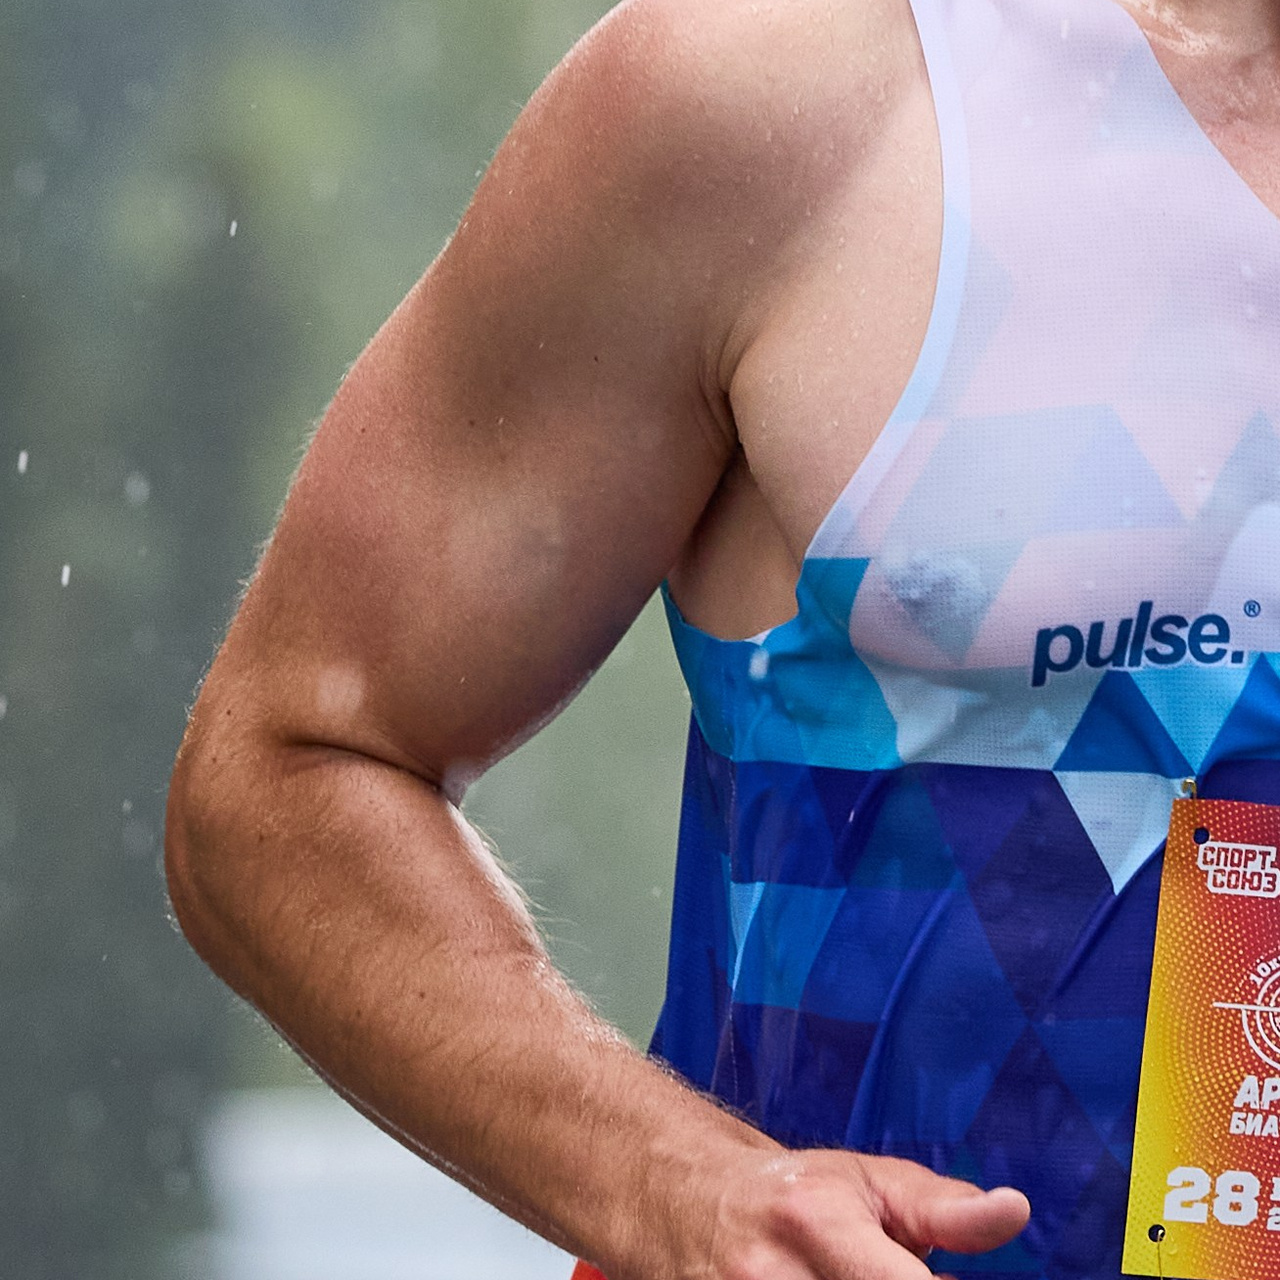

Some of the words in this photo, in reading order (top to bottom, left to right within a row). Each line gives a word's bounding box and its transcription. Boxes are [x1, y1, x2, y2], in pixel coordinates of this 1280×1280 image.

[1202, 846, 1271, 870] СПОРТ
[1213, 870, 1278, 893] СОЮЗ
[1163, 1166, 1261, 1226] 28
